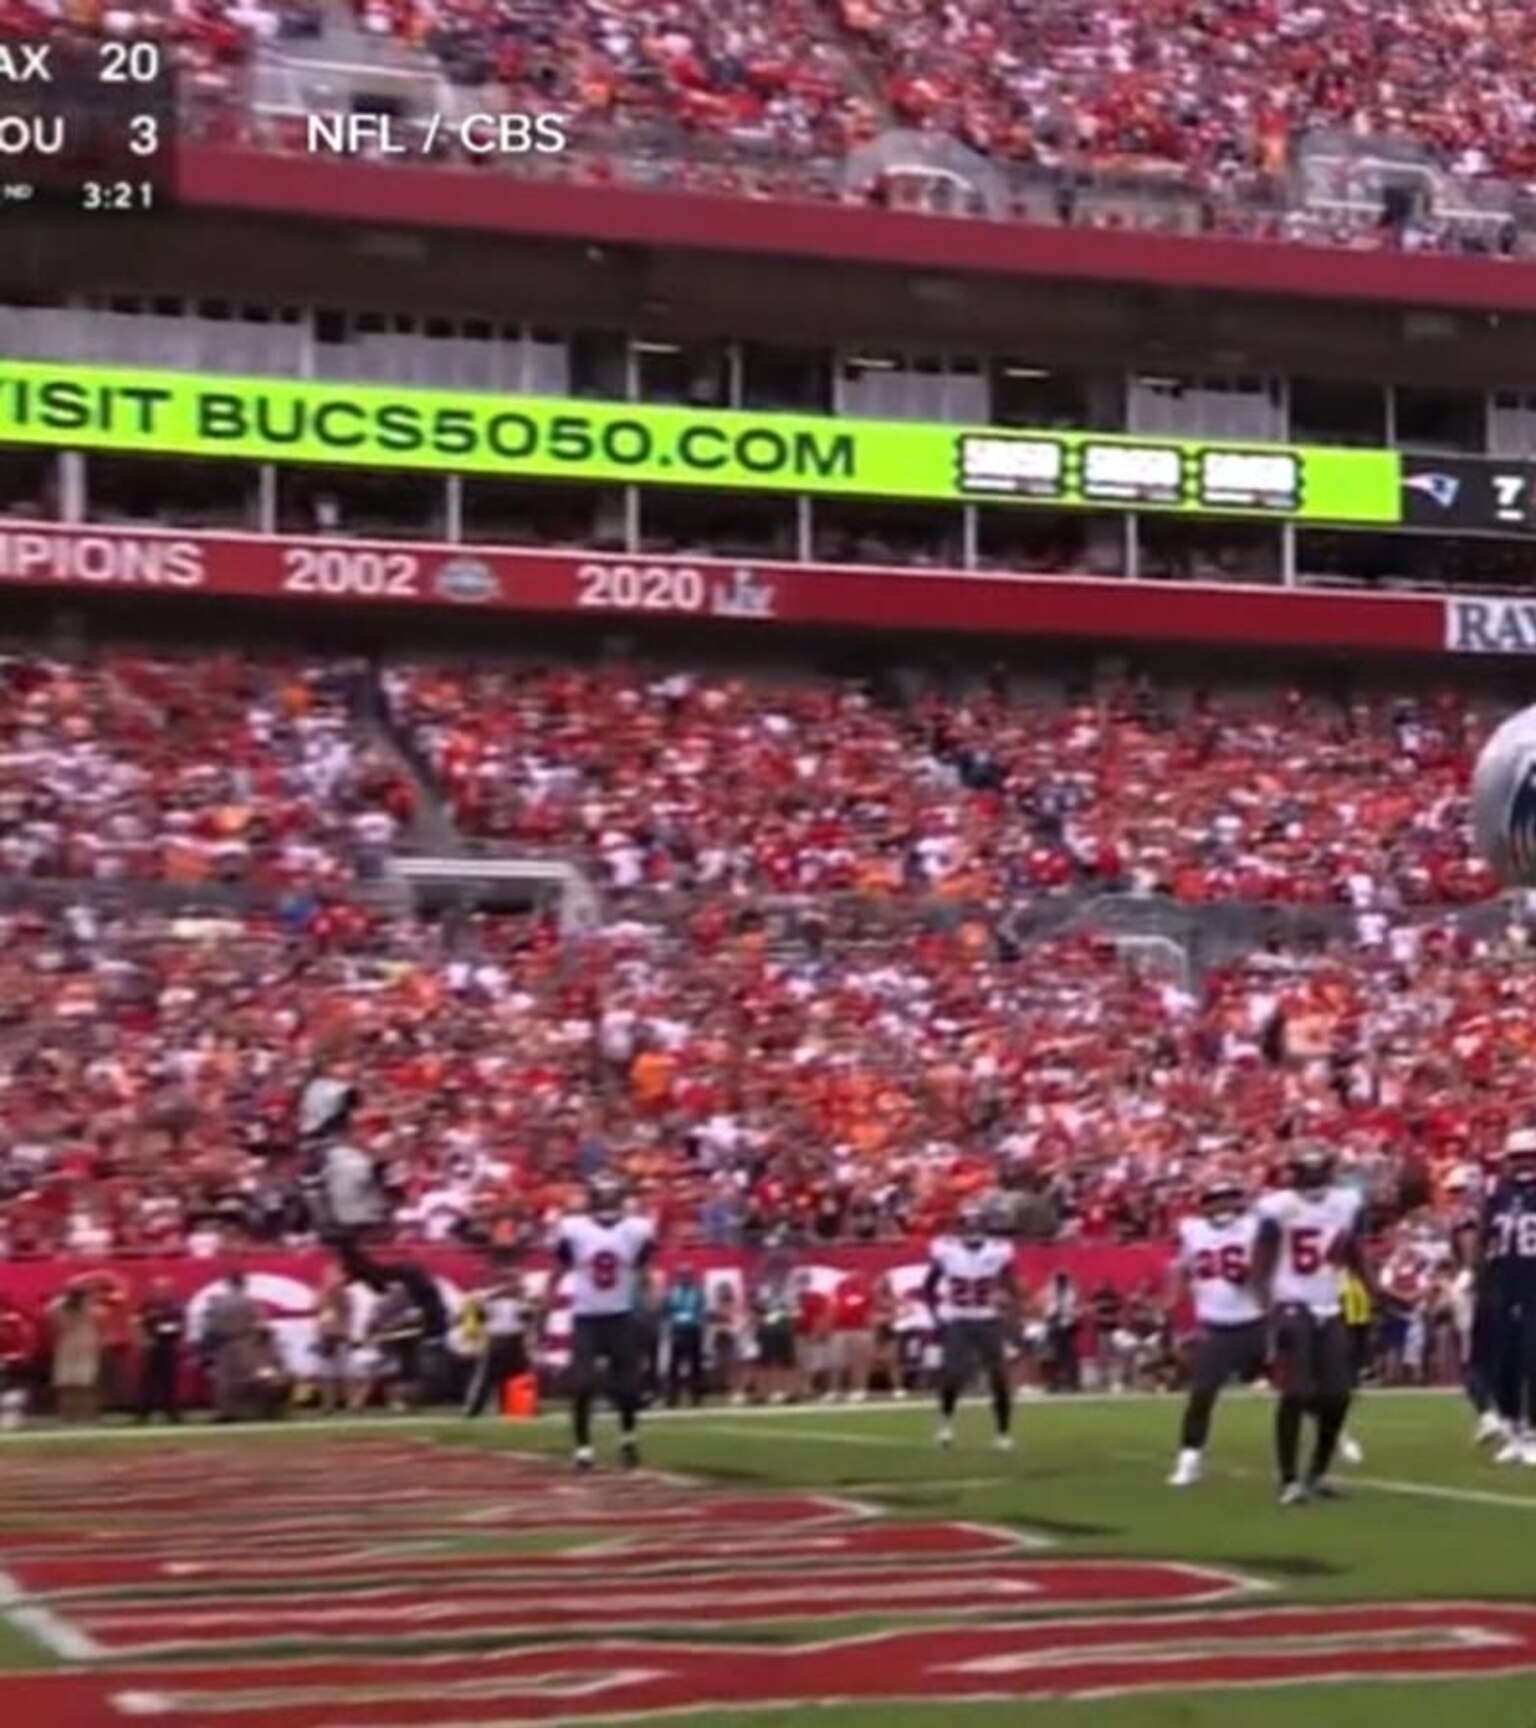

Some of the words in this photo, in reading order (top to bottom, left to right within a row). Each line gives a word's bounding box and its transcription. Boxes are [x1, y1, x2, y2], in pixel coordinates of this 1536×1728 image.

[0, 377, 173, 434] ISIT
[198, 392, 856, 478] BUCS5050.COM
[1492, 475, 1525, 506] 7
[283, 546, 418, 596] 2002
[577, 563, 704, 611] 2020
